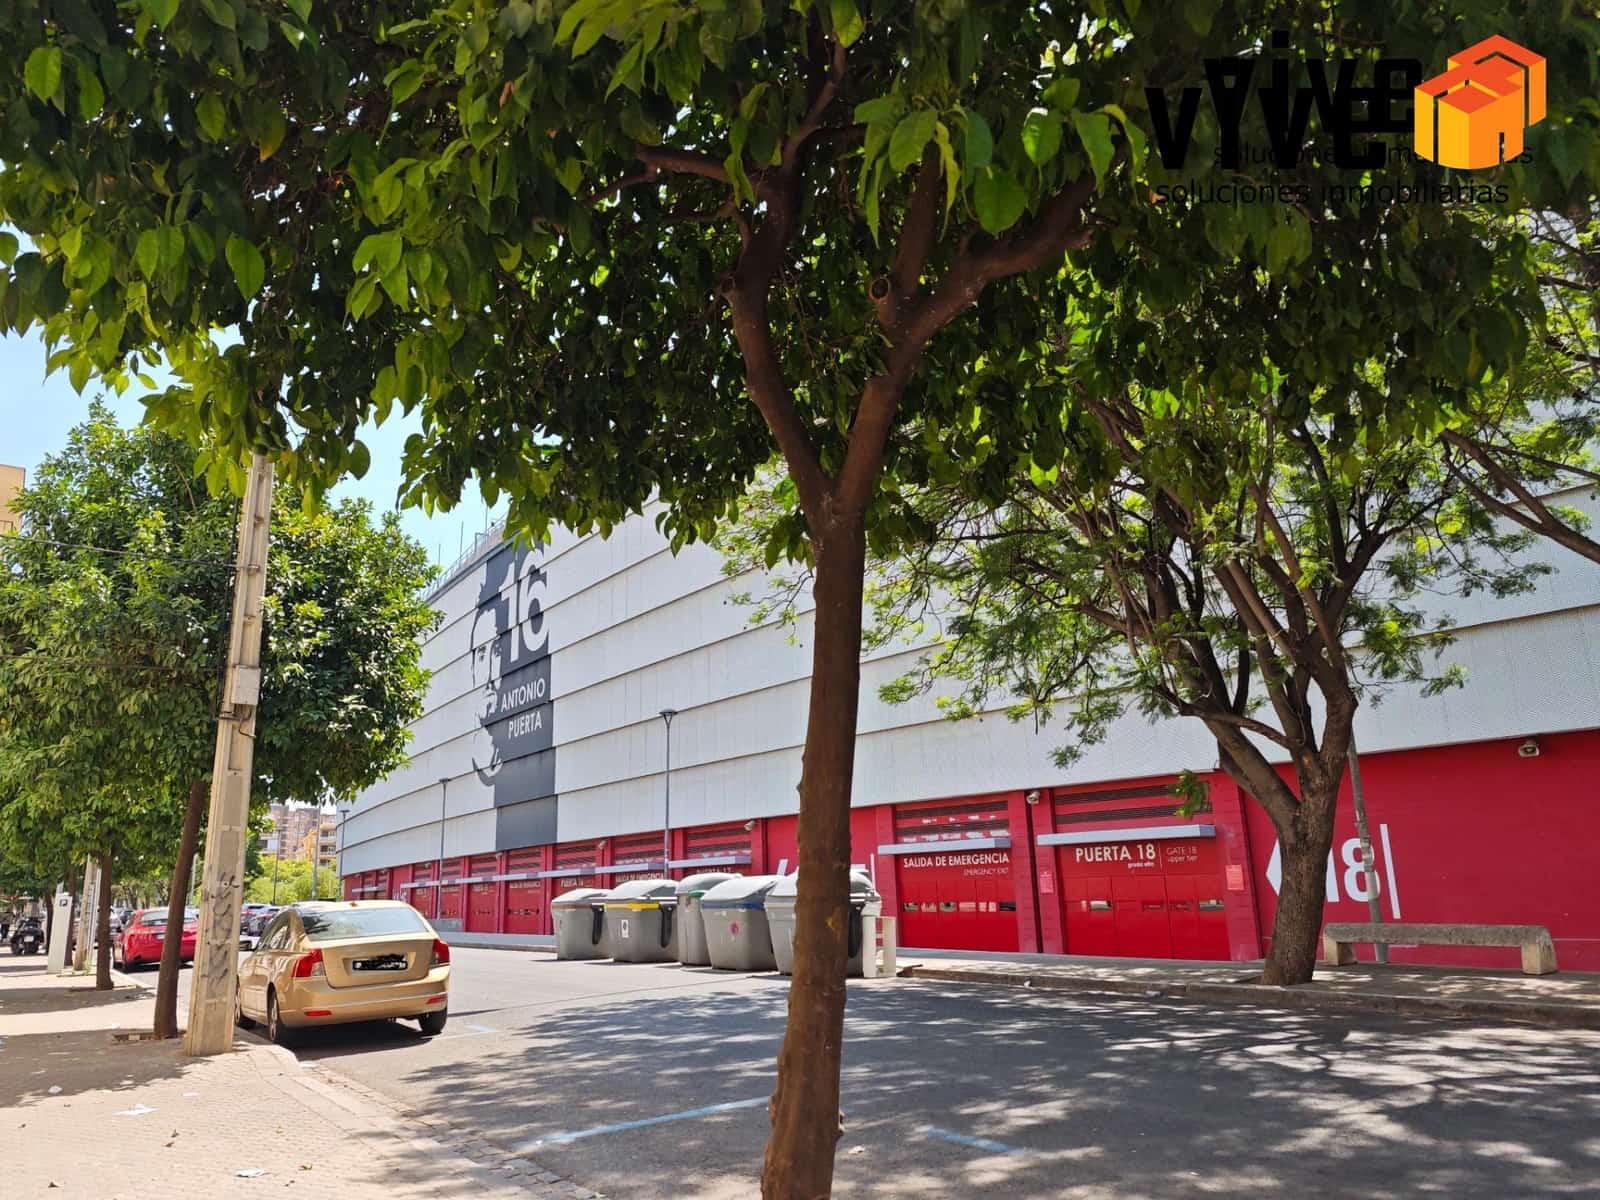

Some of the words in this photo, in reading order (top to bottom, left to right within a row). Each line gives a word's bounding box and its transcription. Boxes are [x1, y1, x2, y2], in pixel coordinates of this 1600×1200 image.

[499, 548, 547, 663] 16
[500, 678, 546, 713] ANTONIO
[508, 711, 543, 740] PUERTA
[903, 857, 934, 868] SALIDA
[935, 855, 947, 866] DE
[948, 852, 1010, 866] EMERGENCIA
[1075, 845, 1132, 863] PUERTA
[1137, 843, 1156, 860] 18
